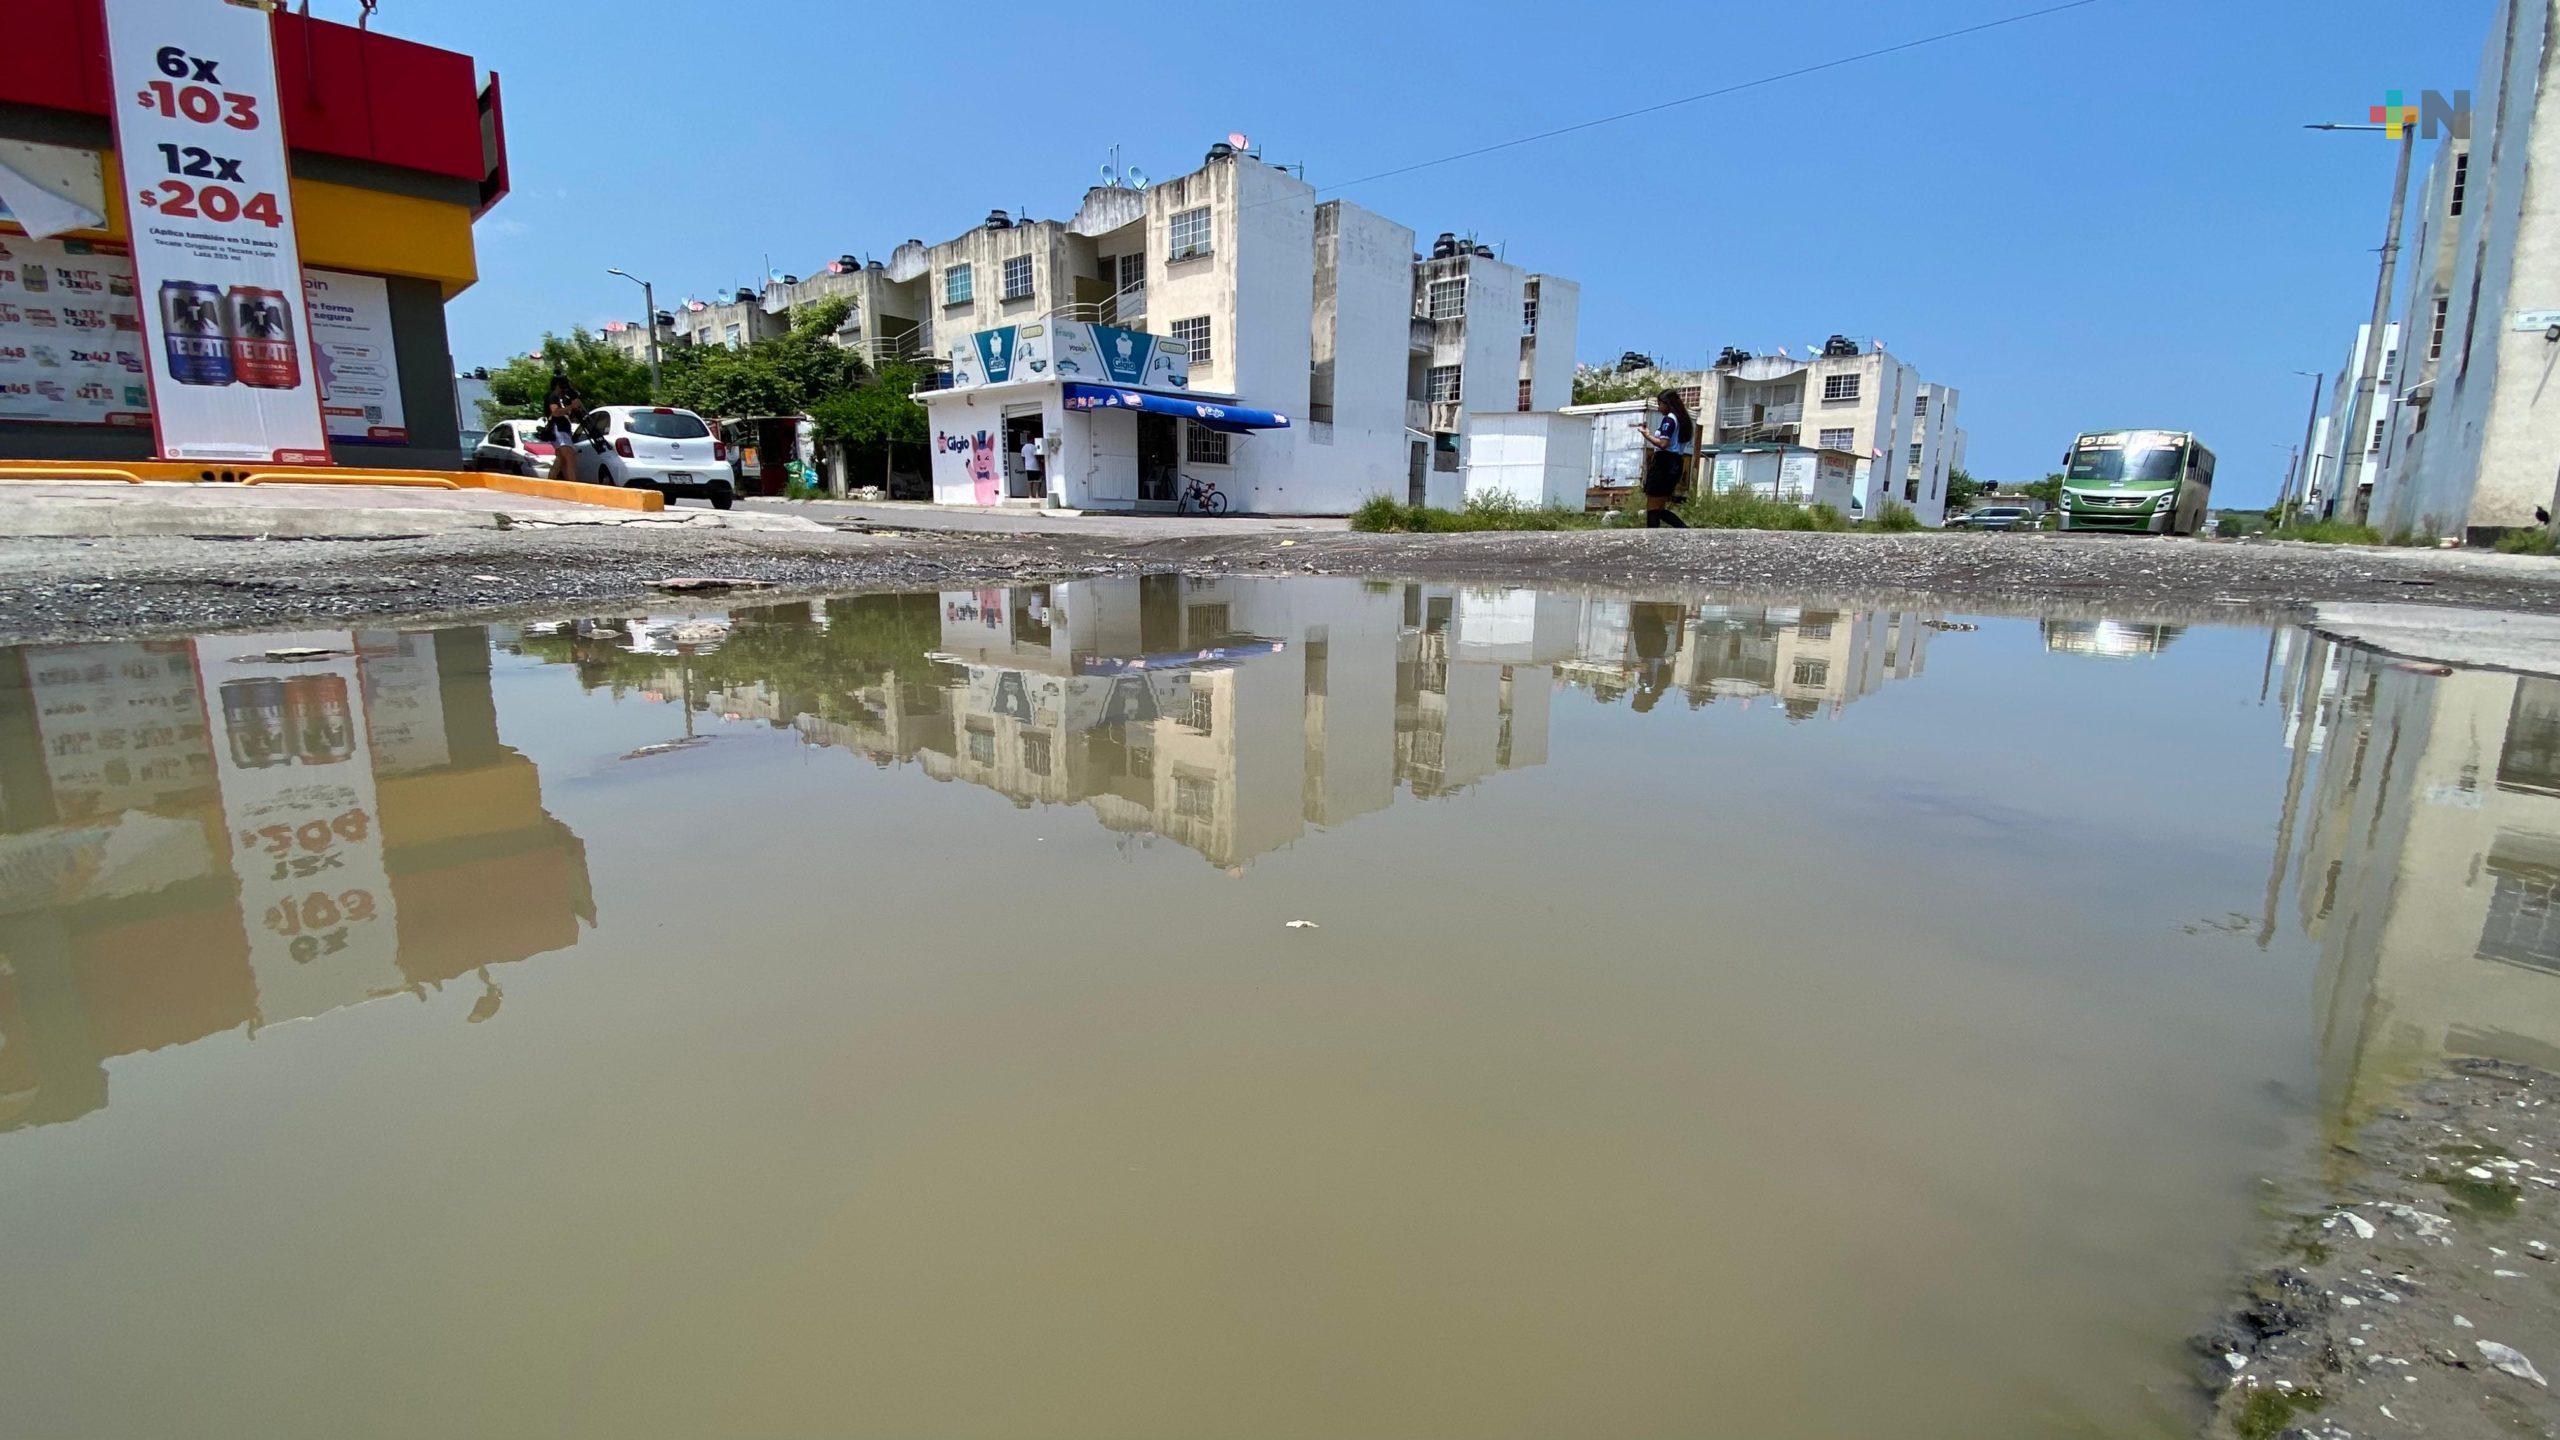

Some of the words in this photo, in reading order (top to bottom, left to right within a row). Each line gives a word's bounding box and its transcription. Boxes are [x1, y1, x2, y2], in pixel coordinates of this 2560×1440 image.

[157, 46, 222, 86] 6x
[137, 80, 260, 130] $103
[157, 143, 245, 184] 12x
[139, 180, 284, 228] $204
[149, 227, 185, 238] (Aplica
[186, 232, 226, 243] también
[240, 237, 251, 245] 12
[252, 239, 279, 249] pack)
[154, 238, 183, 248] Tecate
[184, 242, 218, 252] Original
[226, 246, 254, 256] Tecate
[313, 312, 353, 322] segura
[320, 302, 355, 314] forma
[946, 435, 970, 454] Gigio
